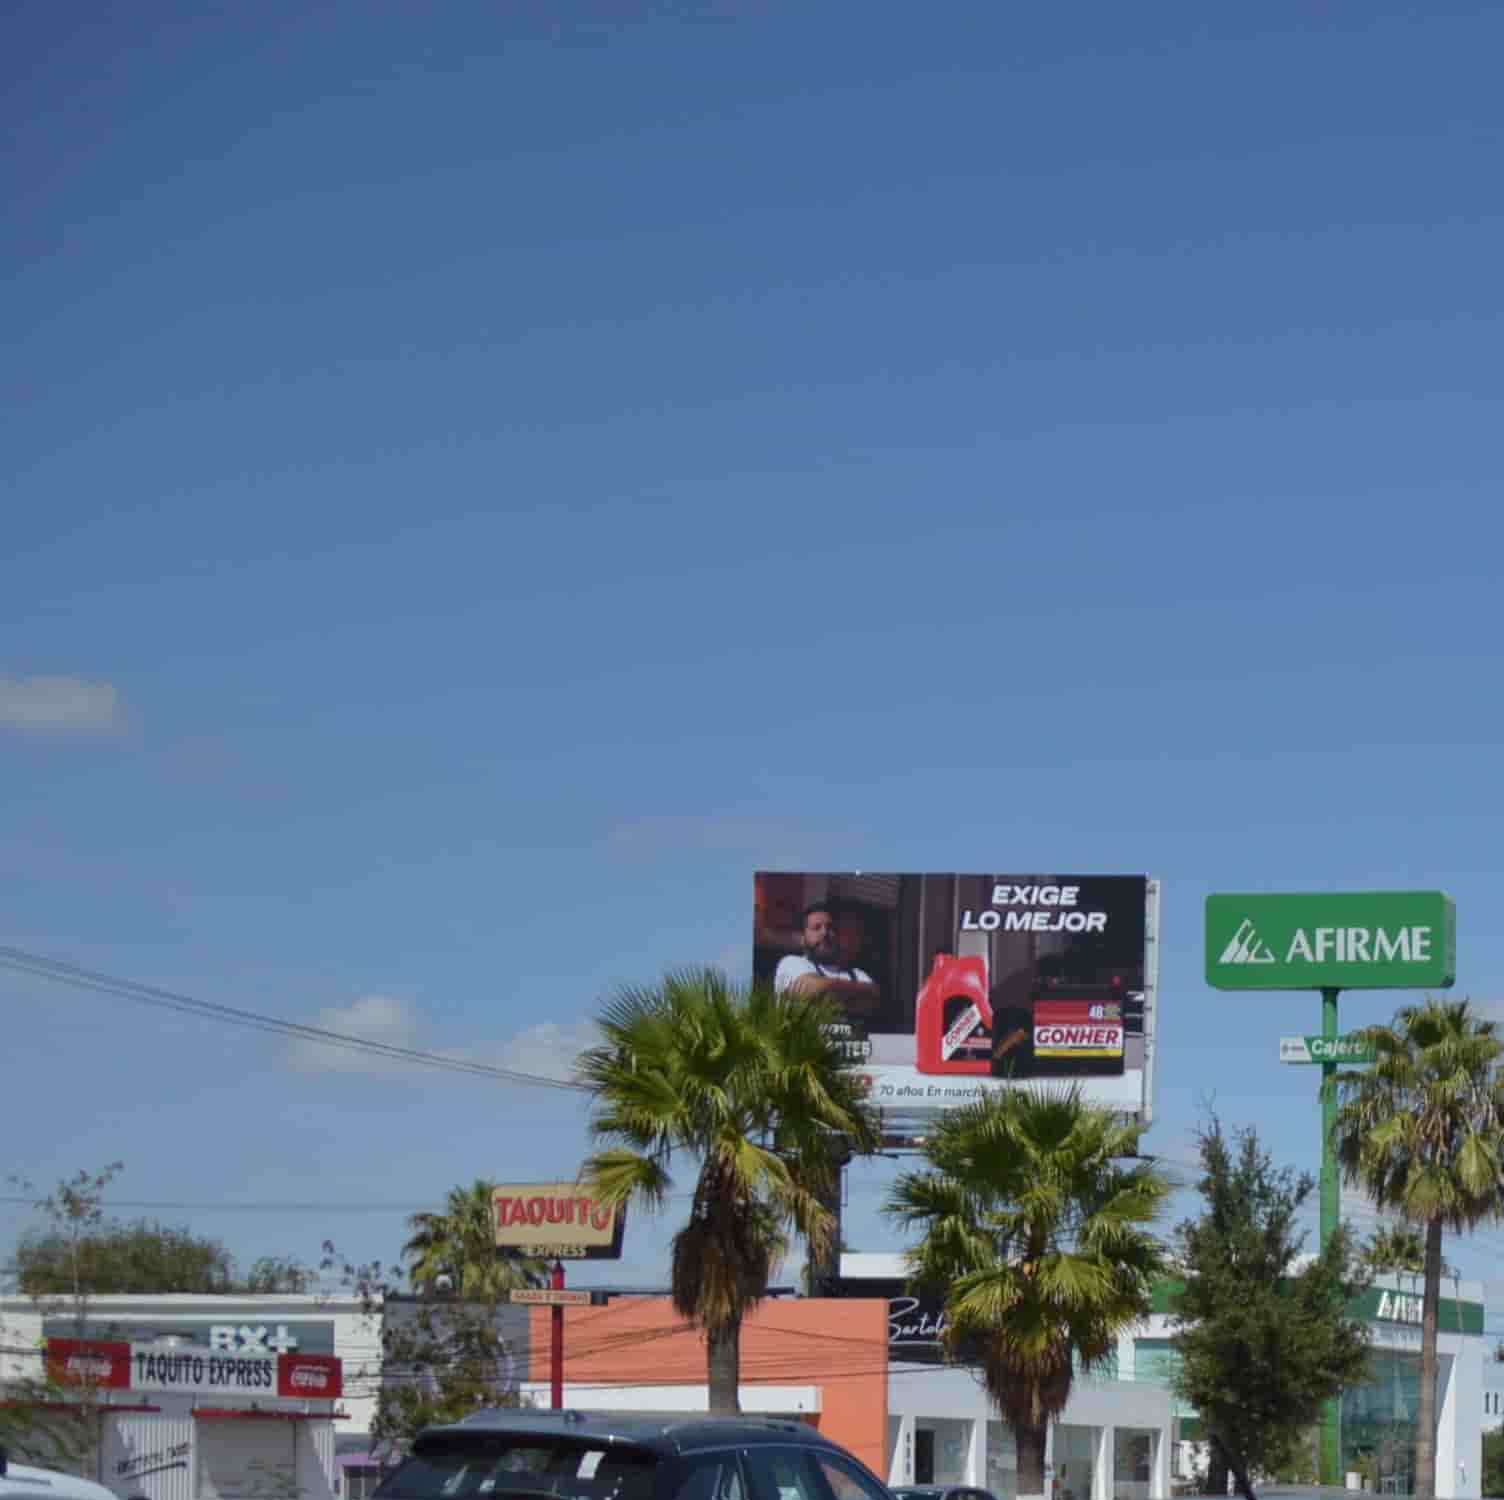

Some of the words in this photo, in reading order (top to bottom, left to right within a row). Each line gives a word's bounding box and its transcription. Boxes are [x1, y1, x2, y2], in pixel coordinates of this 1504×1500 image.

[991, 884, 1080, 907] EXIGE
[961, 909, 1001, 931] LO
[1003, 910, 1108, 933] MEJOR
[1285, 926, 1432, 963] AFIRME
[1036, 1027, 1119, 1046] GONHER
[880, 1084, 894, 1097] 70
[495, 1195, 613, 1231] TAQUITO
[135, 1351, 202, 1385] TAQUITO
[208, 1354, 273, 1388] EXPRESS
